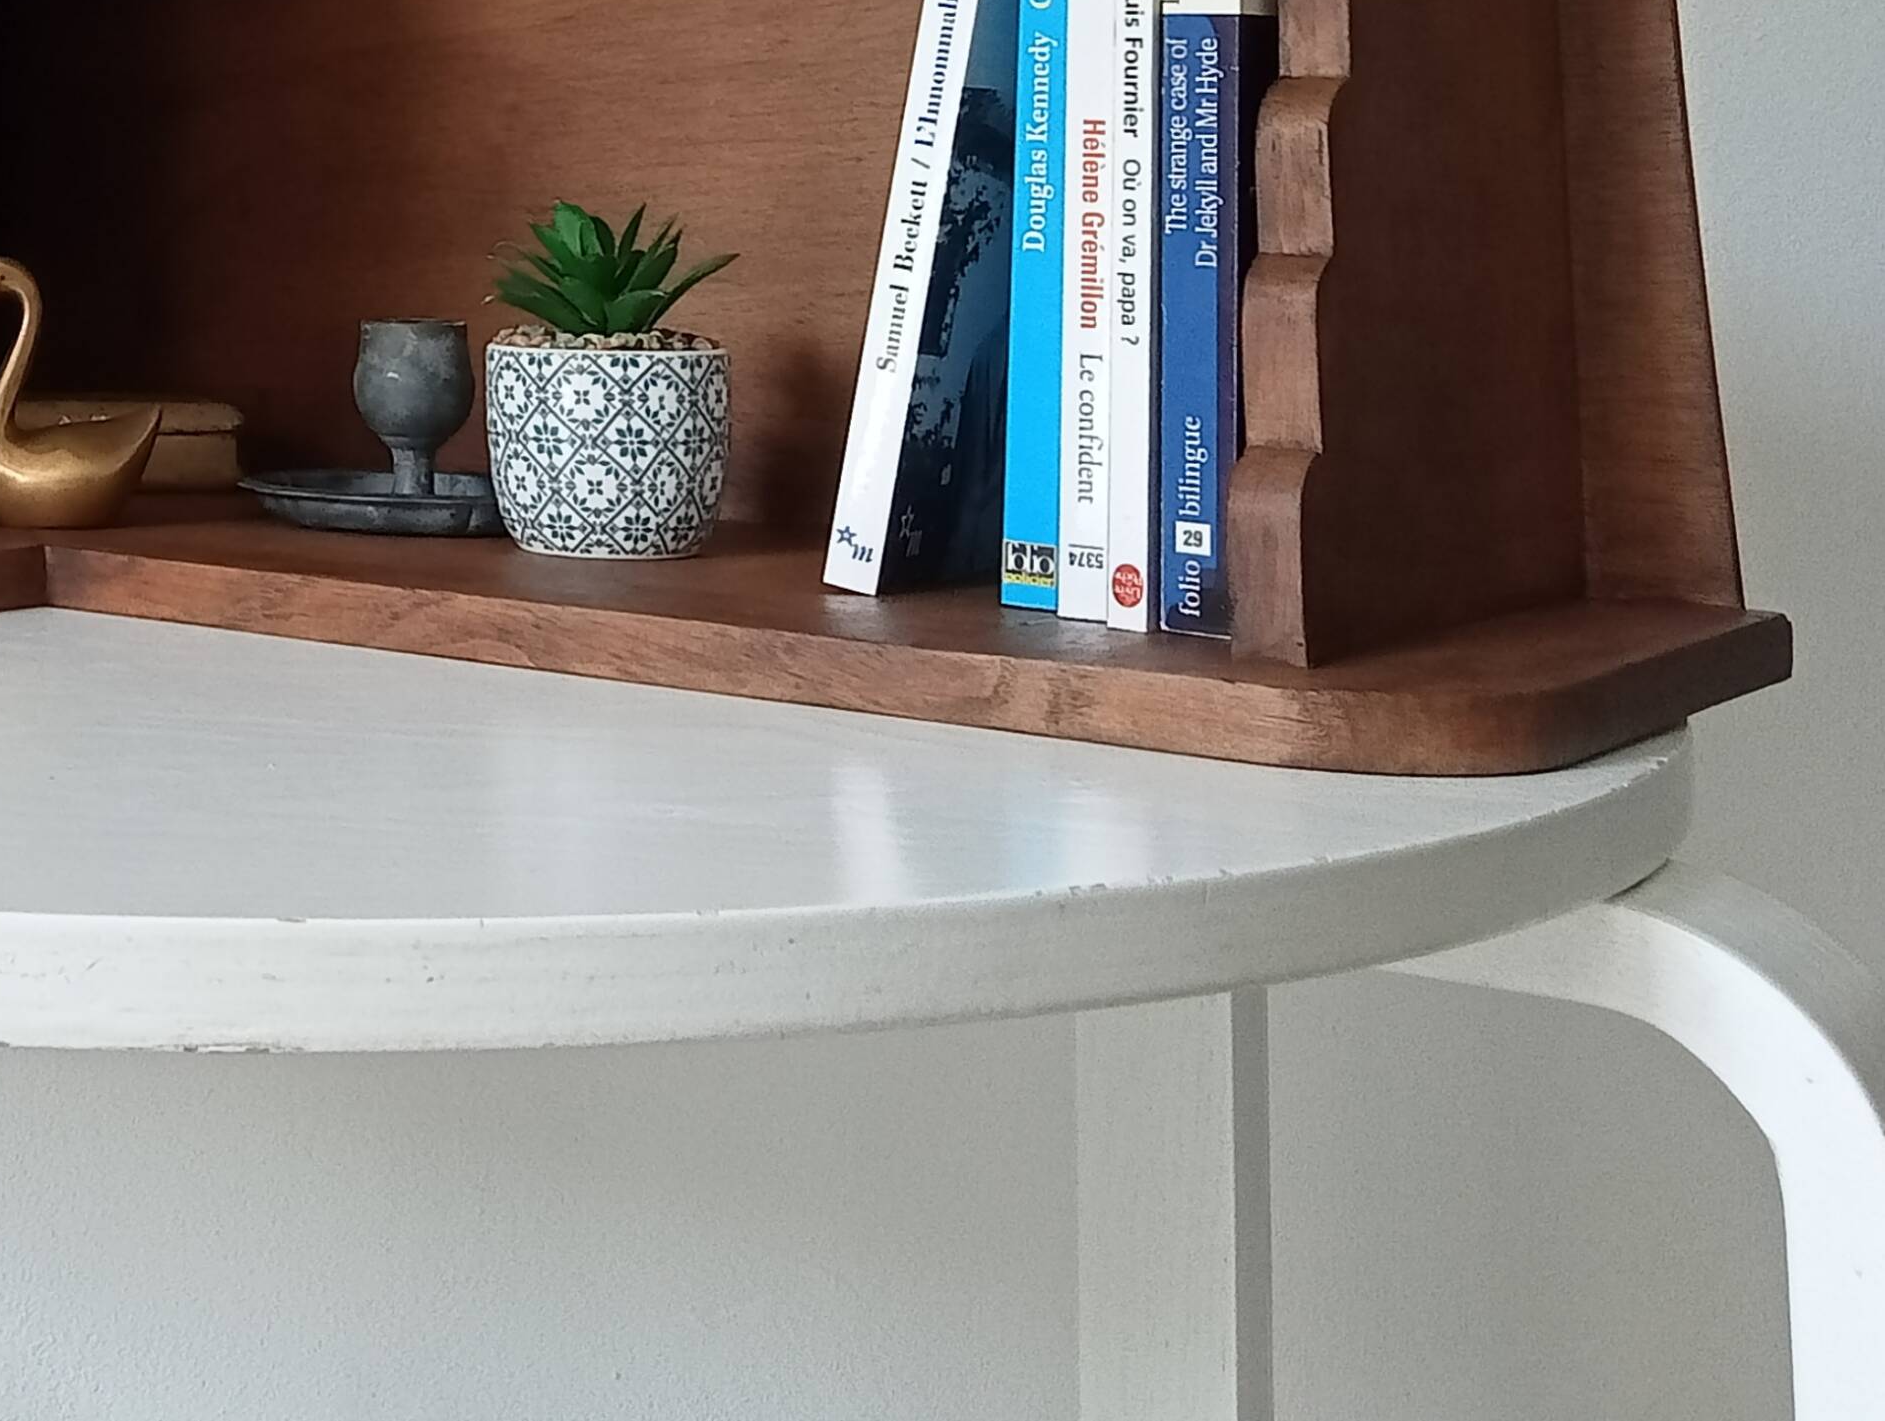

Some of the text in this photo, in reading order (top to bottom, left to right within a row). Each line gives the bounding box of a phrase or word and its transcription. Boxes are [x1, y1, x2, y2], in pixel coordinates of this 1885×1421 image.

[1025, 32, 1058, 142] Kennedy
[1124, 37, 1145, 137] Fournier
[1164, 38, 1192, 234] The strange case of
[1022, 150, 1054, 252] Douglas
[1123, 159, 1142, 190] Où
[1194, 38, 1224, 267] Dr Jekyll and Mr Hyde
[1119, 234, 1137, 263] va,
[1122, 199, 1137, 226] on
[875, 285, 909, 373] Samuel
[892, 180, 927, 273] Beckett
[1078, 119, 1106, 504] Hélène Grémillon Le confident
[1117, 272, 1137, 325] papa
[1121, 335, 1139, 346] ?
[1069, 551, 1104, 569] 5374
[1177, 417, 1207, 617] folio 29 bilingue
